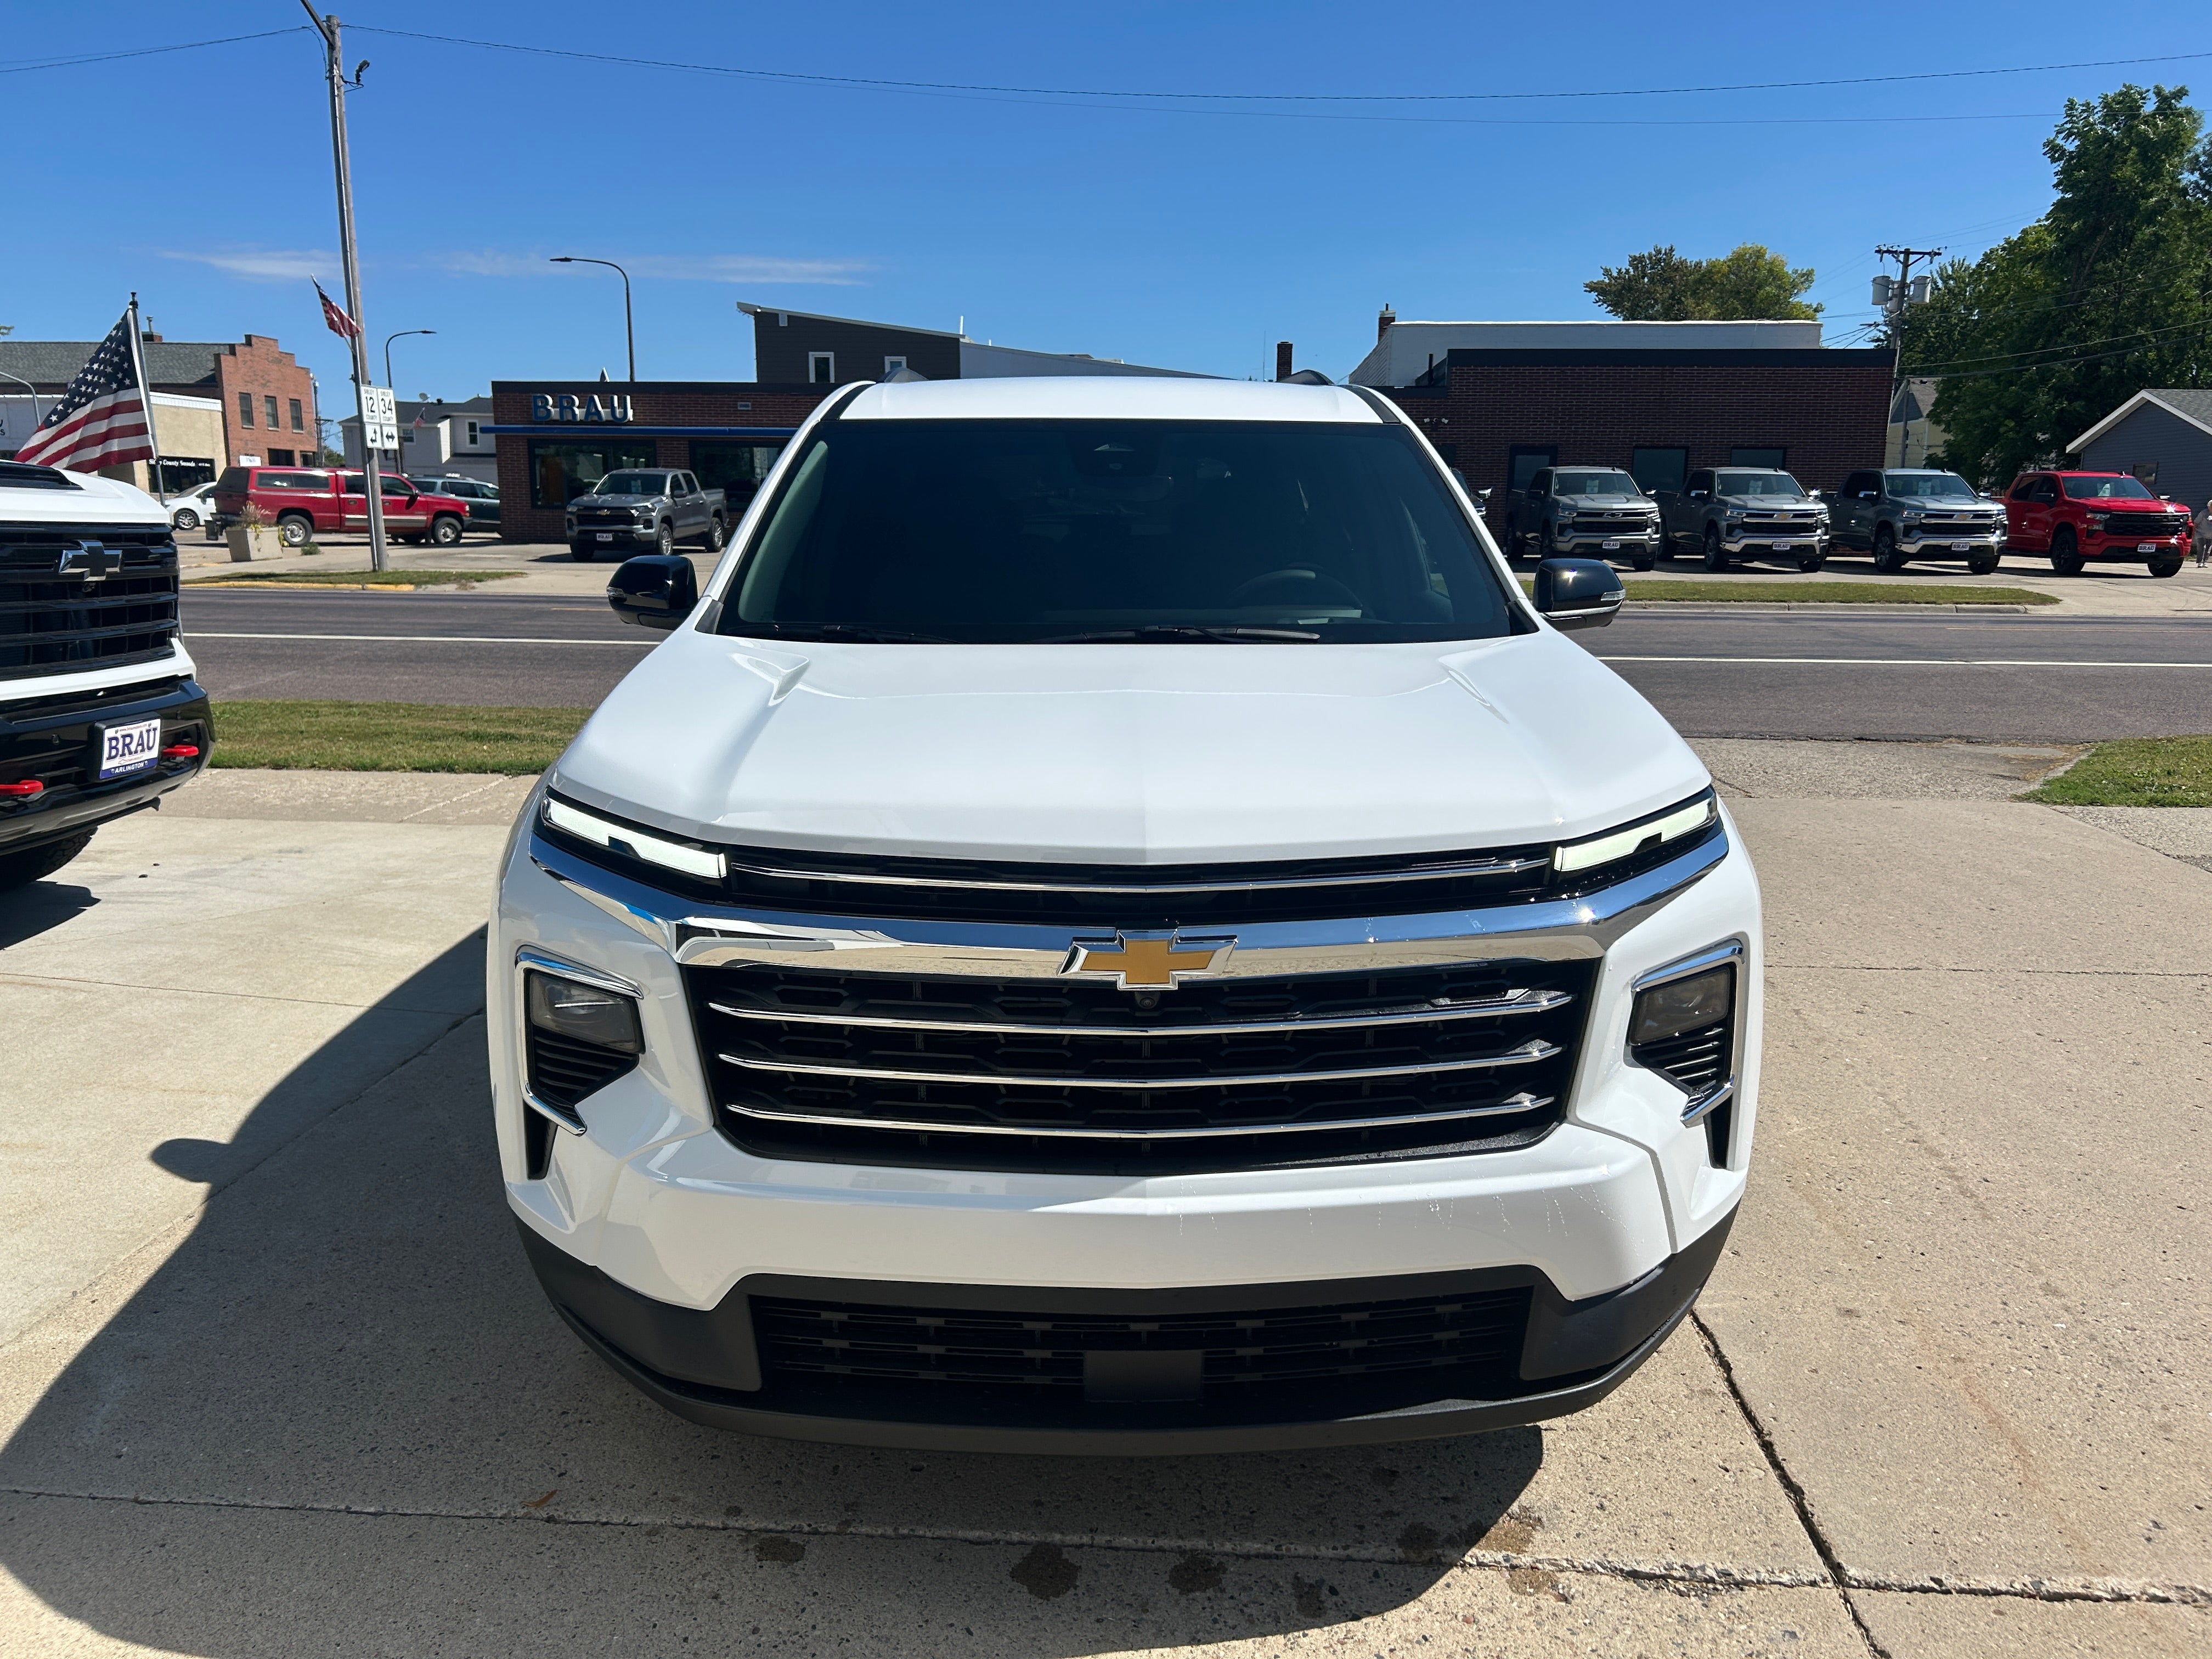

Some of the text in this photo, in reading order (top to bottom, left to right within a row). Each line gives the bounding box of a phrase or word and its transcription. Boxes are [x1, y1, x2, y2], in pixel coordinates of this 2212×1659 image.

[366, 396, 375, 413] 12
[381, 398, 393, 414] 34
[532, 393, 631, 423] BRAU
[105, 726, 157, 762] BRAU
[114, 761, 145, 774] ARLINGTON
